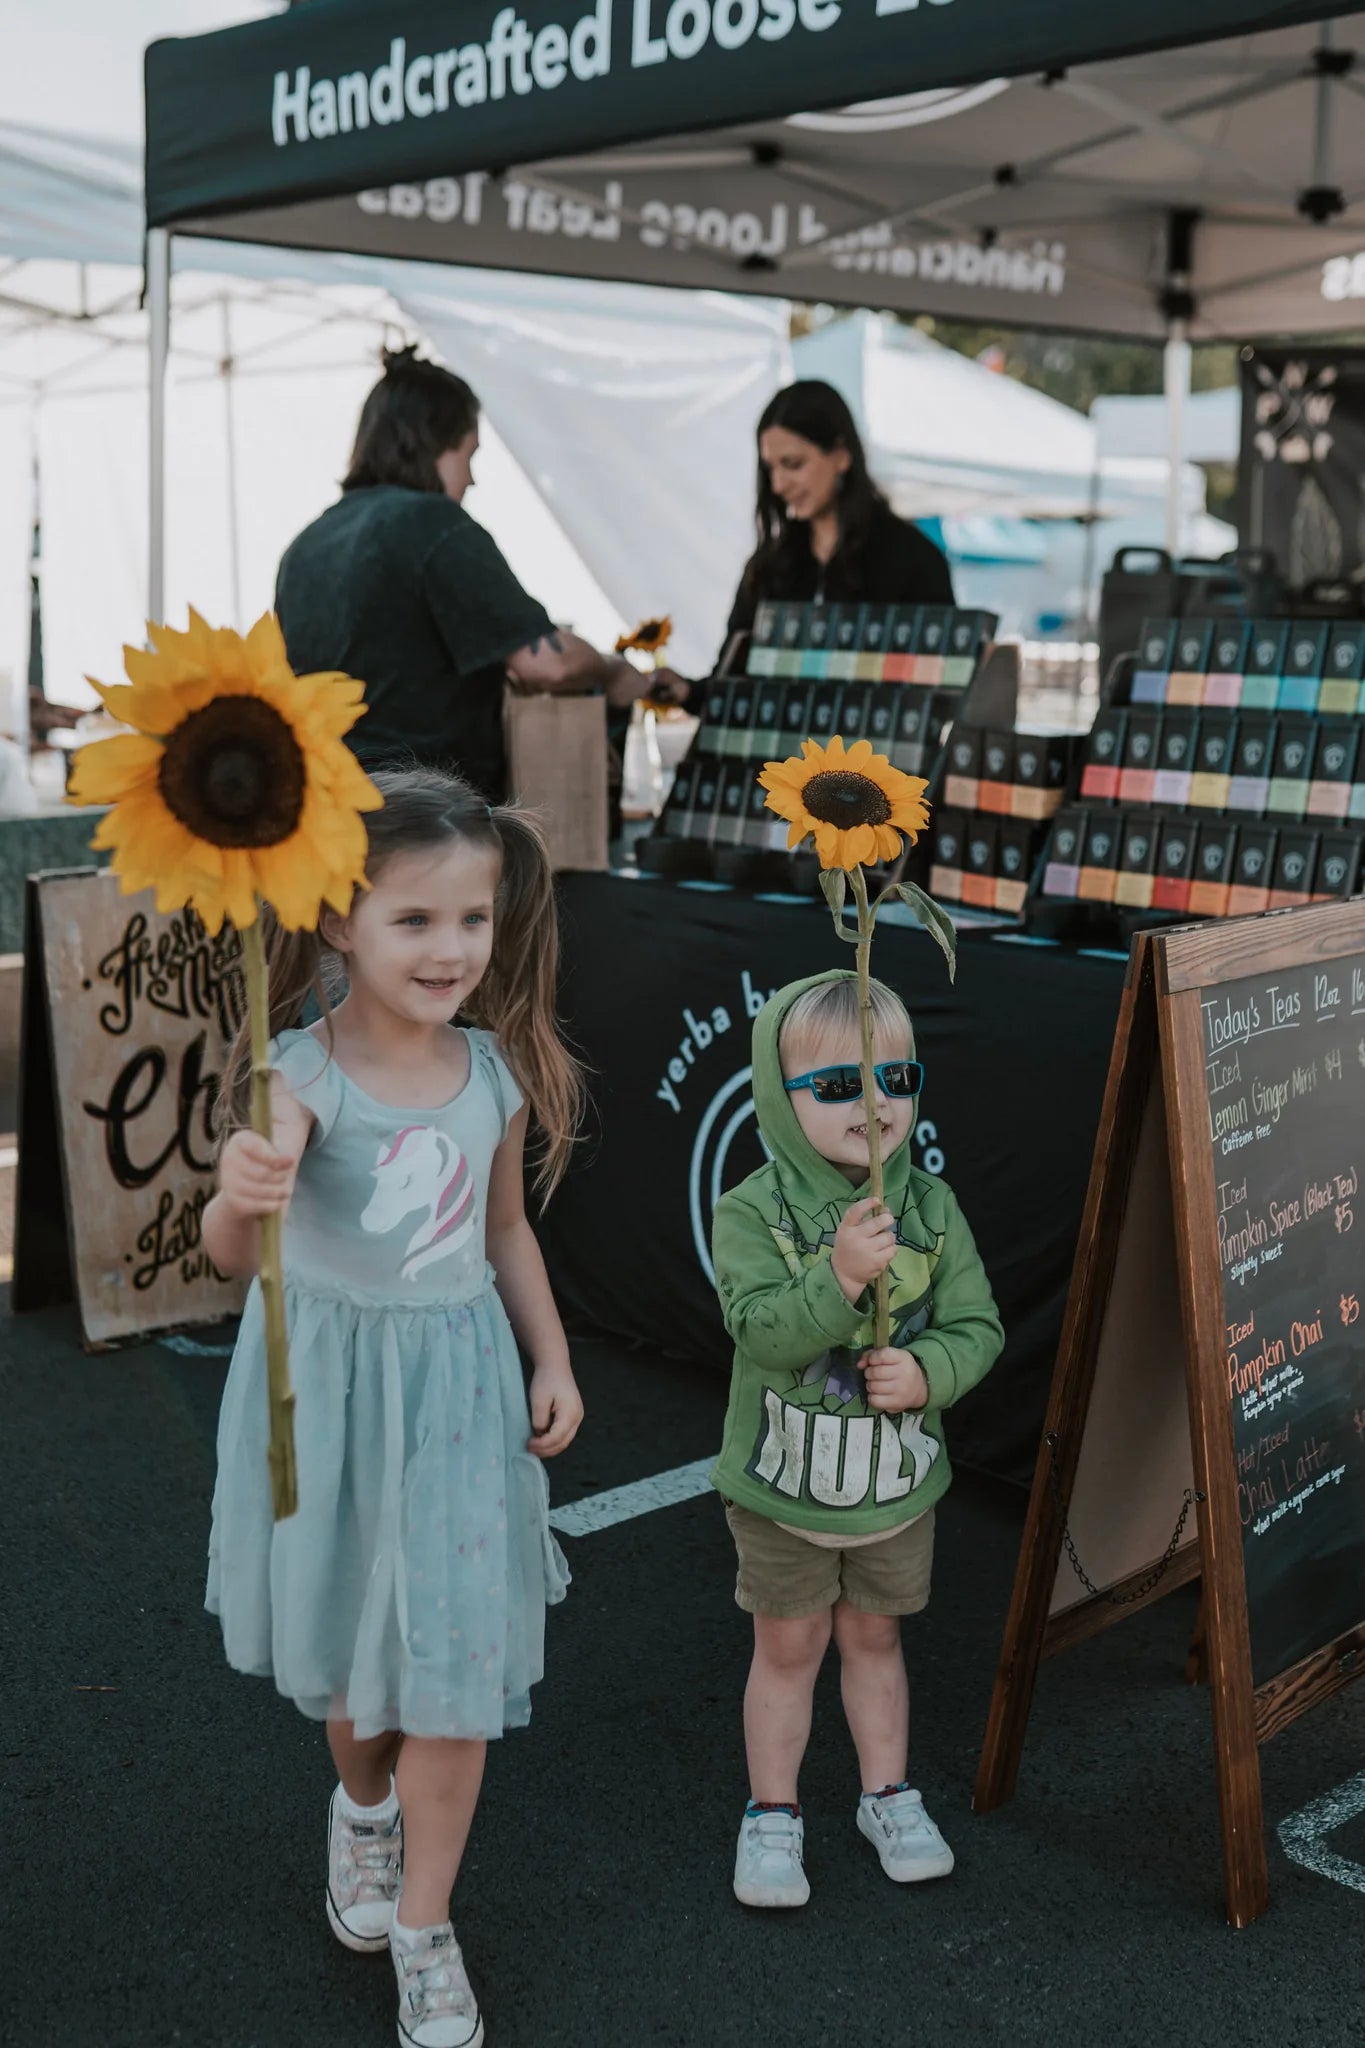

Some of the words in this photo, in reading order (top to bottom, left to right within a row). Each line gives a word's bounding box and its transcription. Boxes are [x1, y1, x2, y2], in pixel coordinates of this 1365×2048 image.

[272, 0, 613, 147] Handcrafted
[1200, 996, 1261, 1048] Today's
[1265, 985, 1301, 1026] Teas
[1313, 974, 1341, 1013] 12oz
[1351, 967, 1365, 1007] 16
[656, 1007, 733, 1114] yerba
[1205, 1050, 1242, 1095] Iced
[1207, 1097, 1249, 1142] Lemon
[1251, 1076, 1290, 1123] Ginger
[1216, 1209, 1269, 1272] Pumpkin
[1269, 1200, 1302, 1238] Spice
[1303, 1182, 1334, 1220] (Black
[1332, 1165, 1358, 1200] Tea)
[1217, 1177, 1248, 1214] Iced
[1334, 1201, 1354, 1234] $5
[1226, 1309, 1255, 1349] Iced
[1226, 1337, 1287, 1400] Pumpkin
[1289, 1308, 1324, 1356] Chai
[1339, 1293, 1360, 1327] $5
